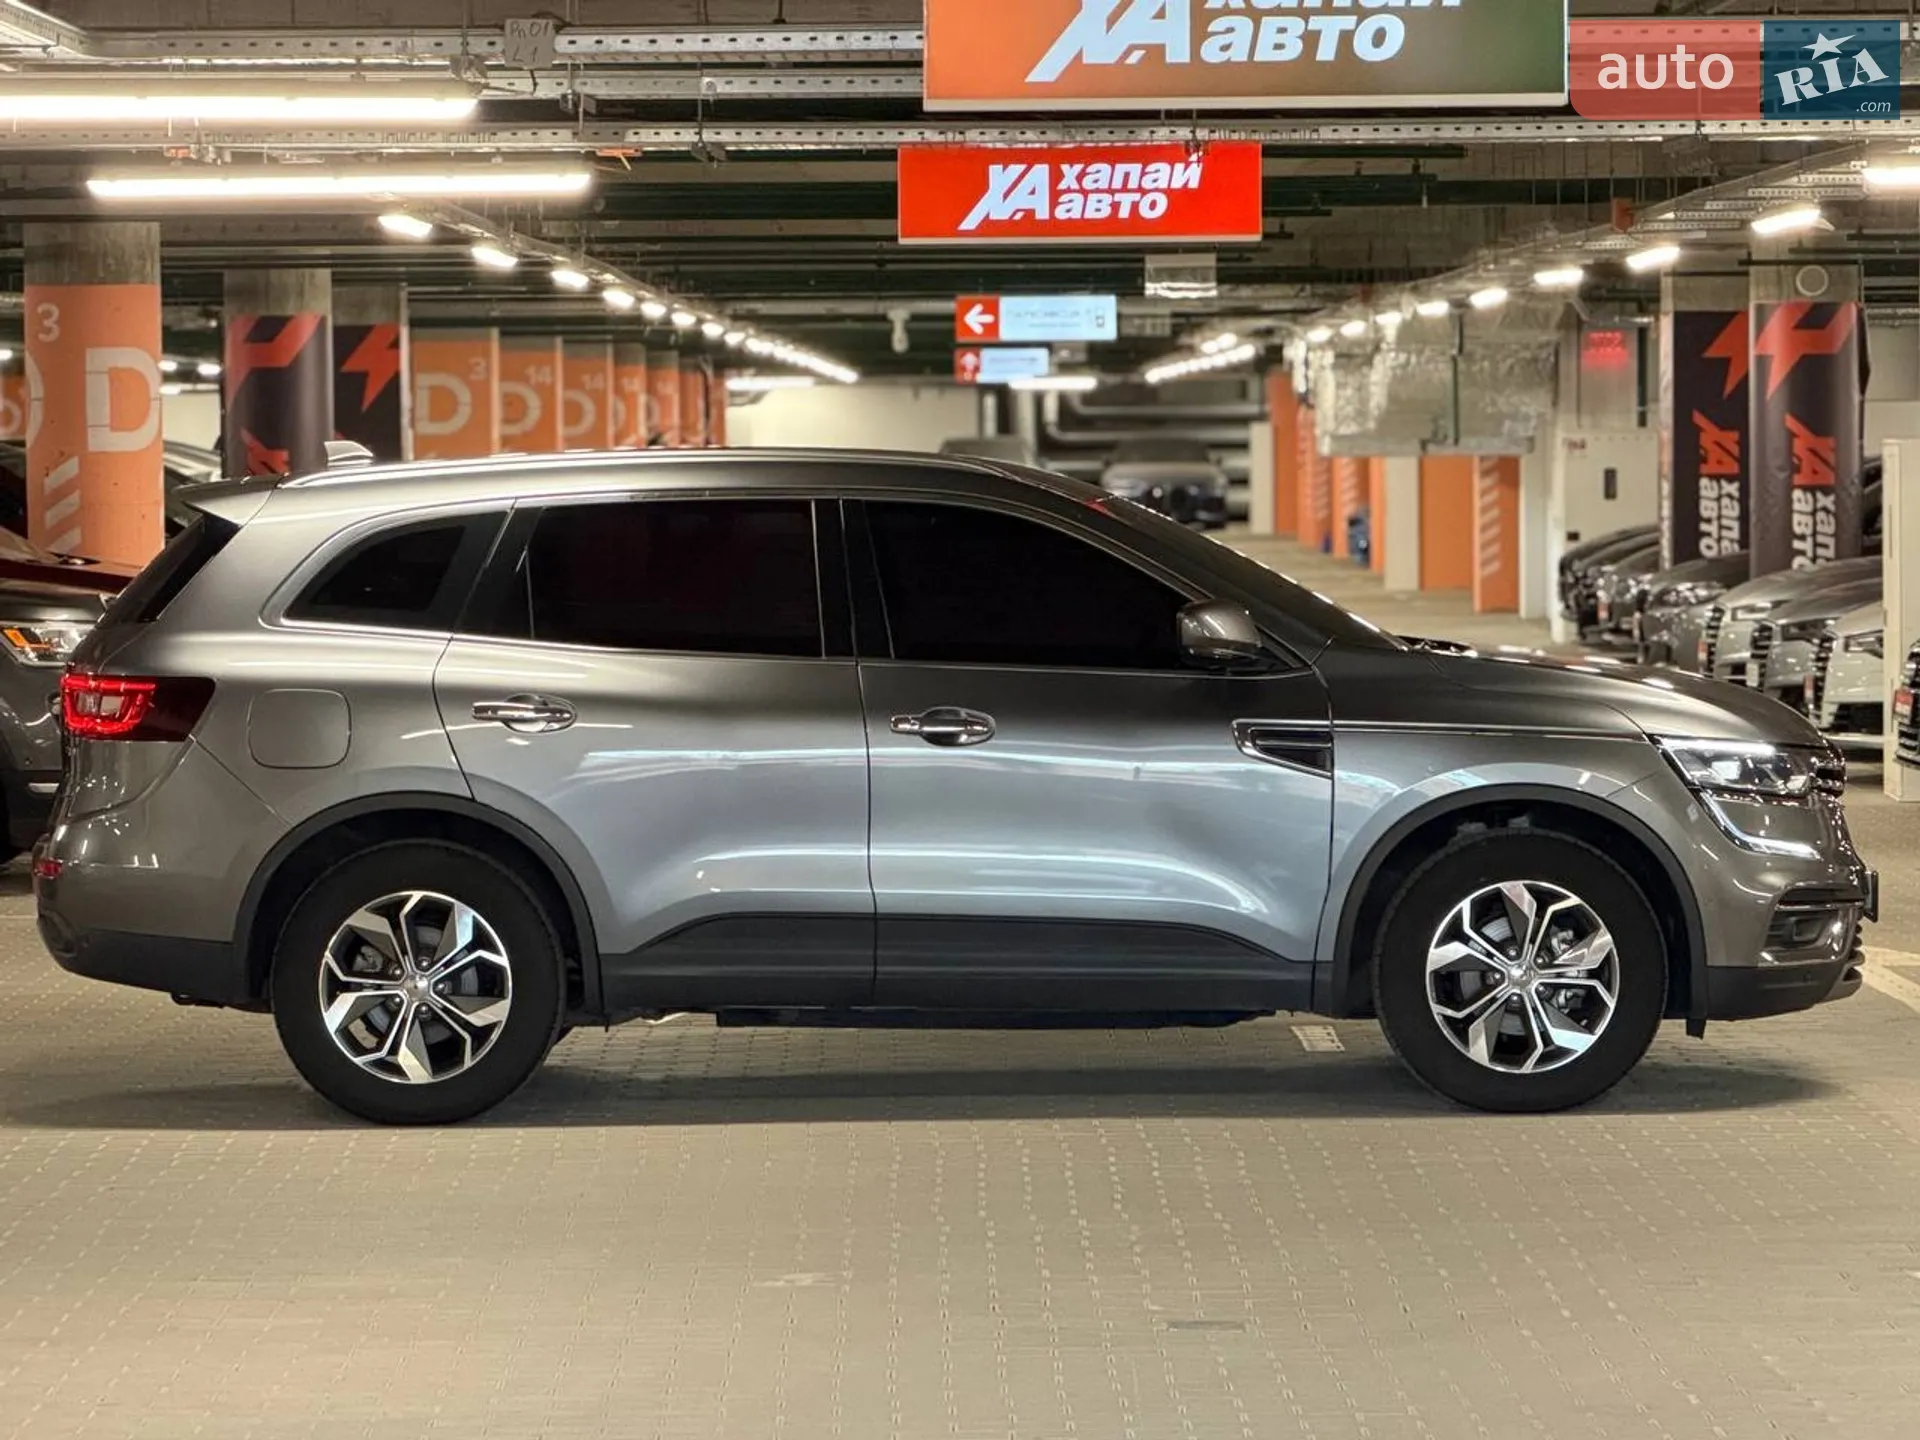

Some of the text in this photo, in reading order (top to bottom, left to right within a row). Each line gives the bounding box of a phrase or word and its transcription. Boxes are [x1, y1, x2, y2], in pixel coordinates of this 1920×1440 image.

[1200, 13, 1405, 63] авто
[1056, 151, 1204, 190] хапай
[1054, 191, 1168, 219] авто
[37, 303, 60, 342] 3
[86, 347, 161, 453] D
[415, 372, 472, 435] D
[1699, 477, 1719, 559] авто
